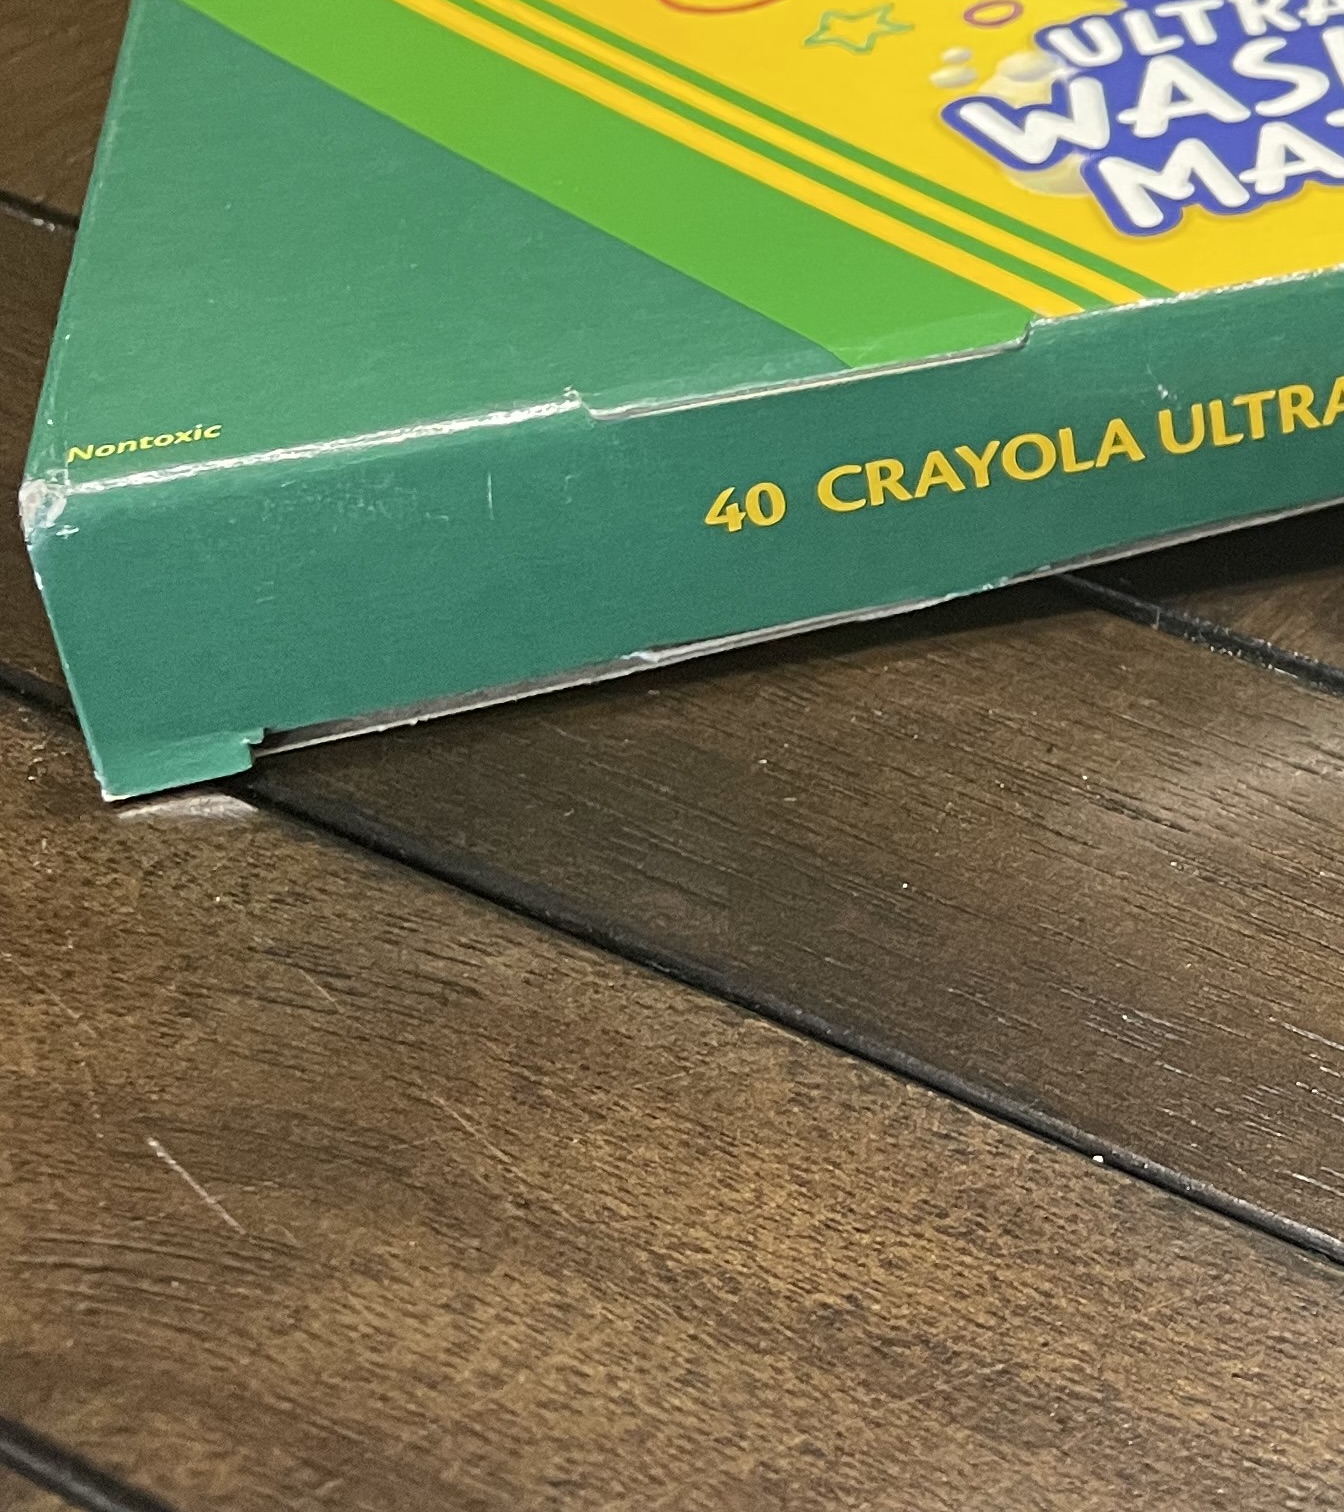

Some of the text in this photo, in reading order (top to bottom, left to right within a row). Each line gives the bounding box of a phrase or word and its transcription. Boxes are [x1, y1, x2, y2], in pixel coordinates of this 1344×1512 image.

[66, 423, 223, 464] Nontoxic
[703, 480, 788, 534] 40
[815, 416, 1147, 514] CRAYOLA
